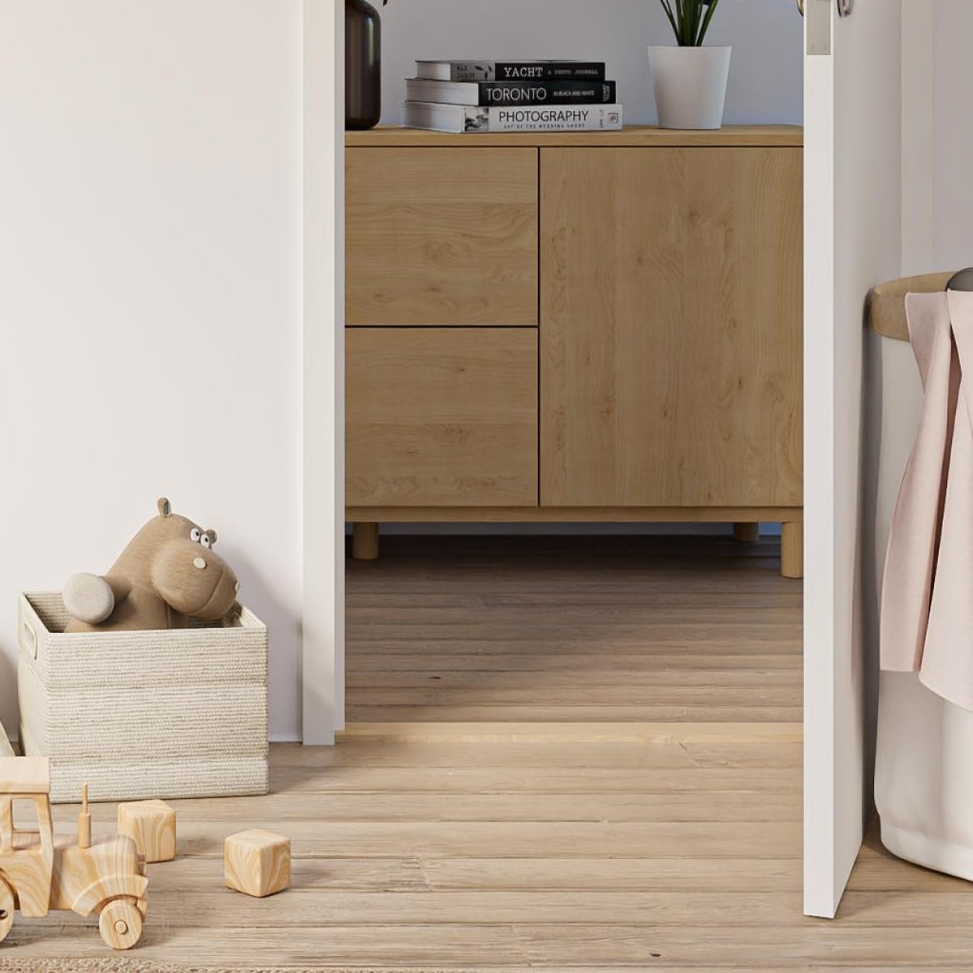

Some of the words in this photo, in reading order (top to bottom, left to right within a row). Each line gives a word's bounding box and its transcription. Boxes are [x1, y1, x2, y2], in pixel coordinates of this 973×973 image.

[504, 67, 544, 77] YACHT
[486, 87, 547, 101] TORONTO
[498, 110, 589, 123] PHOTOGRAPHY
